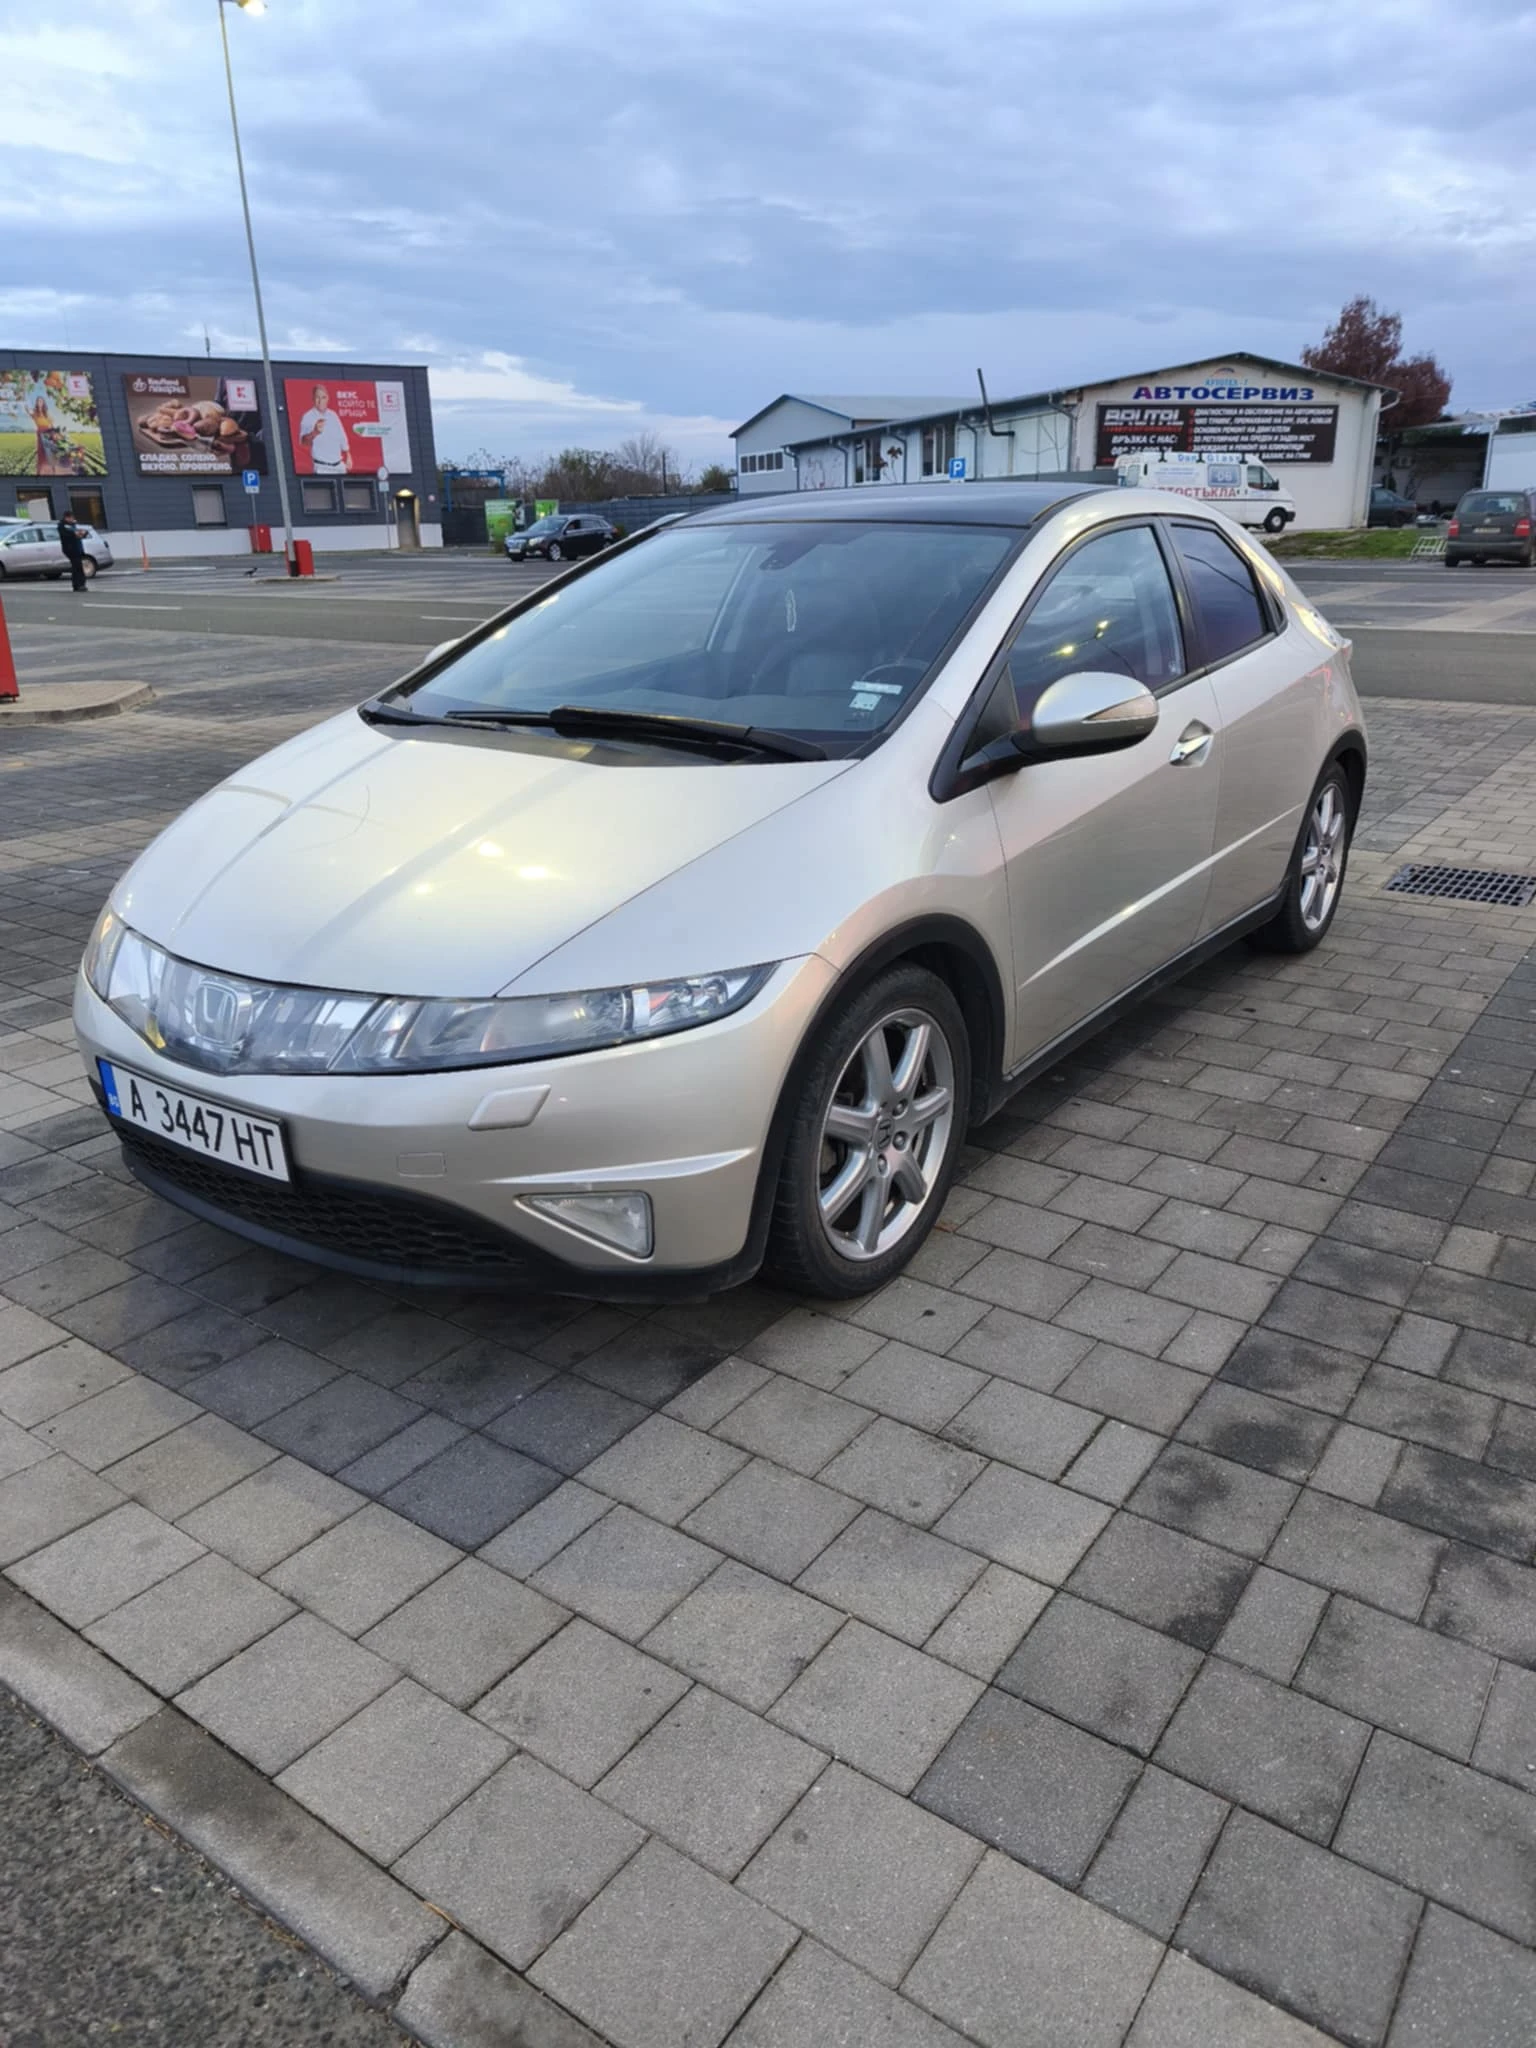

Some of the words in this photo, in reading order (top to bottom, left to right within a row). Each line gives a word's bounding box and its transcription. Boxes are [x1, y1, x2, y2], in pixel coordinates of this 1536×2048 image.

[1133, 386, 1314, 400] АВТОСЕРВИЗ
[1111, 435, 1147, 444] ВРЪЗКА
[1149, 435, 1157, 444] С
[130, 1079, 147, 1122] A
[156, 1091, 224, 1152] 3447
[231, 1117, 275, 1170] HT
